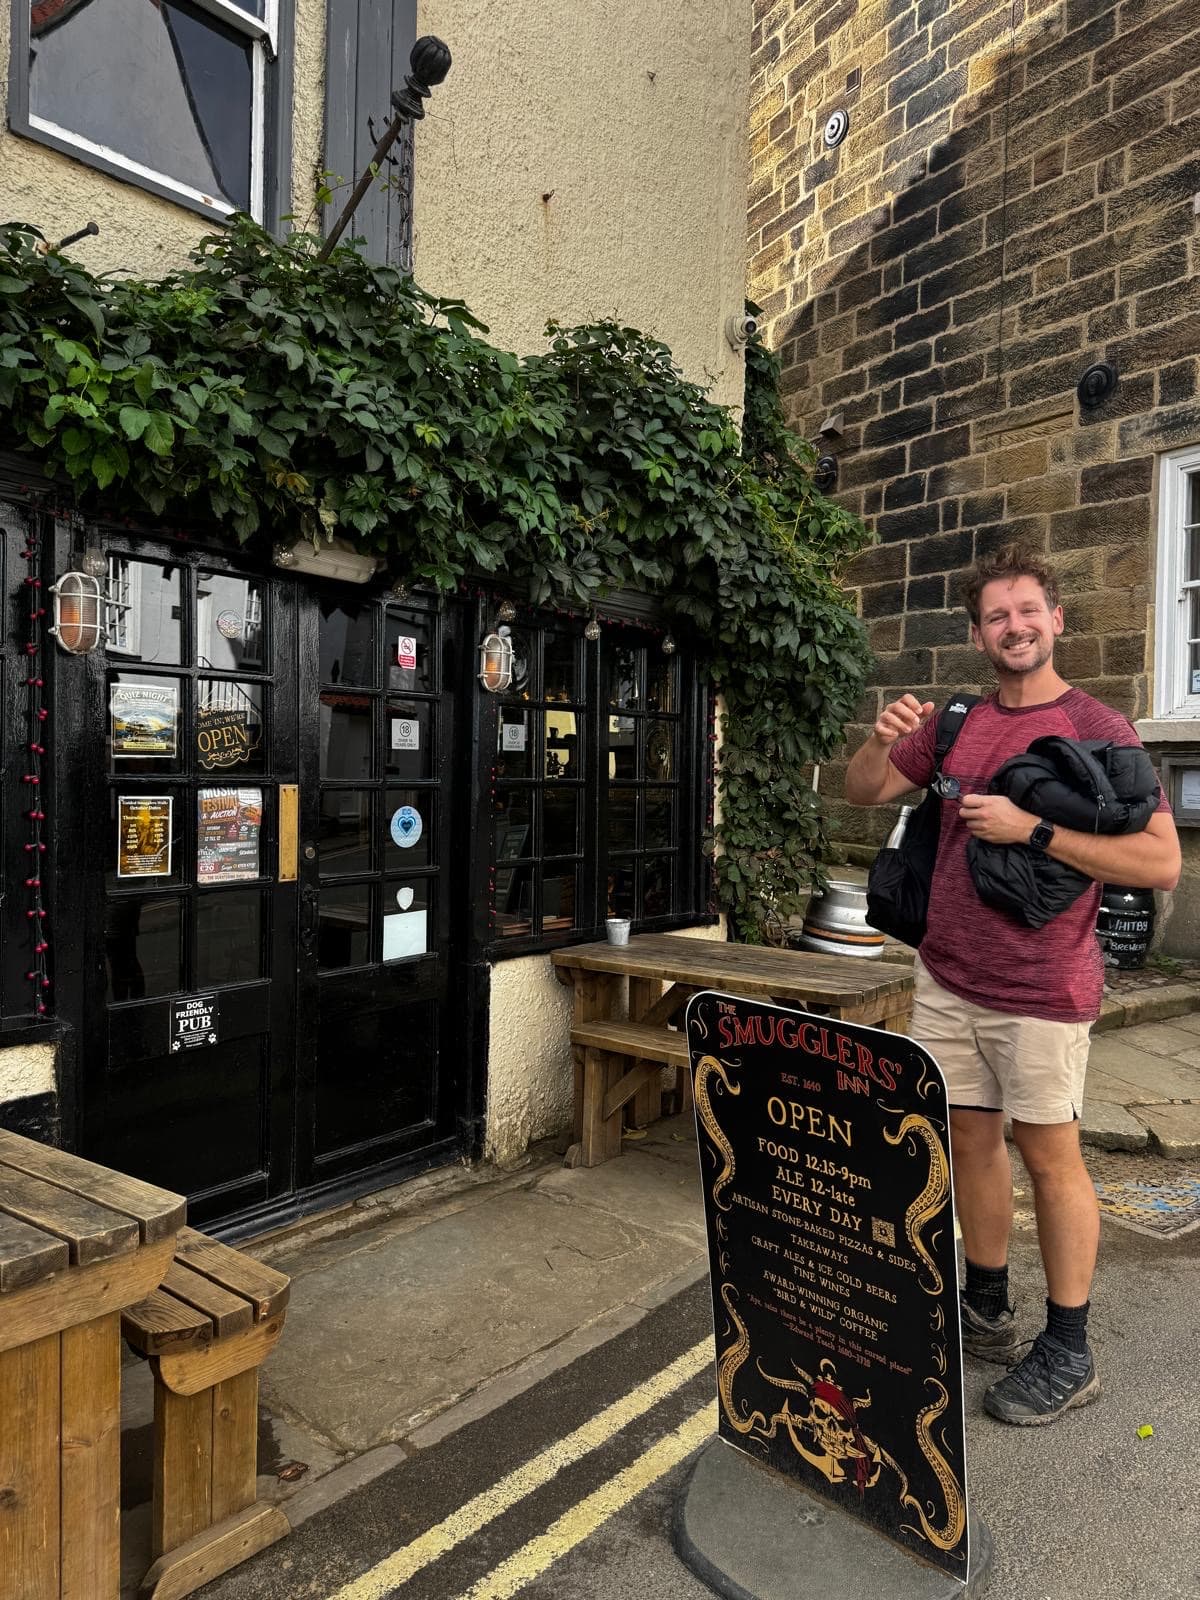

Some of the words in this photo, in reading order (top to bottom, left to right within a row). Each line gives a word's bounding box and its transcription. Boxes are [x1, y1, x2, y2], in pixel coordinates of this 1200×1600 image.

[120, 690, 140, 701] QUIZ
[142, 691, 169, 702] NIGHT
[198, 723, 247, 752] OPEN
[210, 809, 237, 819] AUCTION
[176, 1006, 214, 1018] FRIENDLY
[186, 1001, 203, 1009] DOG
[716, 1000, 736, 1016] THE
[178, 1015, 211, 1032] PUB
[718, 1016, 902, 1090] SMUGGLERS'
[781, 1072, 800, 1087] EST.
[803, 1079, 821, 1092] 1640
[837, 1070, 869, 1096] INN
[768, 1096, 852, 1146] OPEN
[758, 1137, 798, 1162] FOOD
[776, 1166, 804, 1187] ALE
[811, 1178, 856, 1206] 12-late
[772, 1185, 822, 1216] EVERY
[830, 1207, 862, 1230] DAY
[732, 1192, 768, 1214] ARTISAN
[772, 1209, 835, 1240] STONE-BAKED
[839, 1235, 873, 1255] PIZZAS
[877, 1250, 884, 1260] &
[888, 1254, 917, 1272] SIDES
[790, 1234, 848, 1264] TAKEAWAYS
[752, 1235, 780, 1254] CRAFT
[784, 1249, 805, 1265] ALES
[808, 1260, 815, 1269] &
[818, 1263, 833, 1276] ICE
[836, 1271, 862, 1288] COLD
[866, 1283, 897, 1303] BEERS
[794, 1265, 816, 1282] FINE
[820, 1276, 850, 1297] WINES
[763, 1270, 840, 1310] AWARD-WINNING
[844, 1306, 888, 1332] ORGANIC
[800, 1300, 806, 1309] &
[839, 1317, 878, 1341] COFFEE
